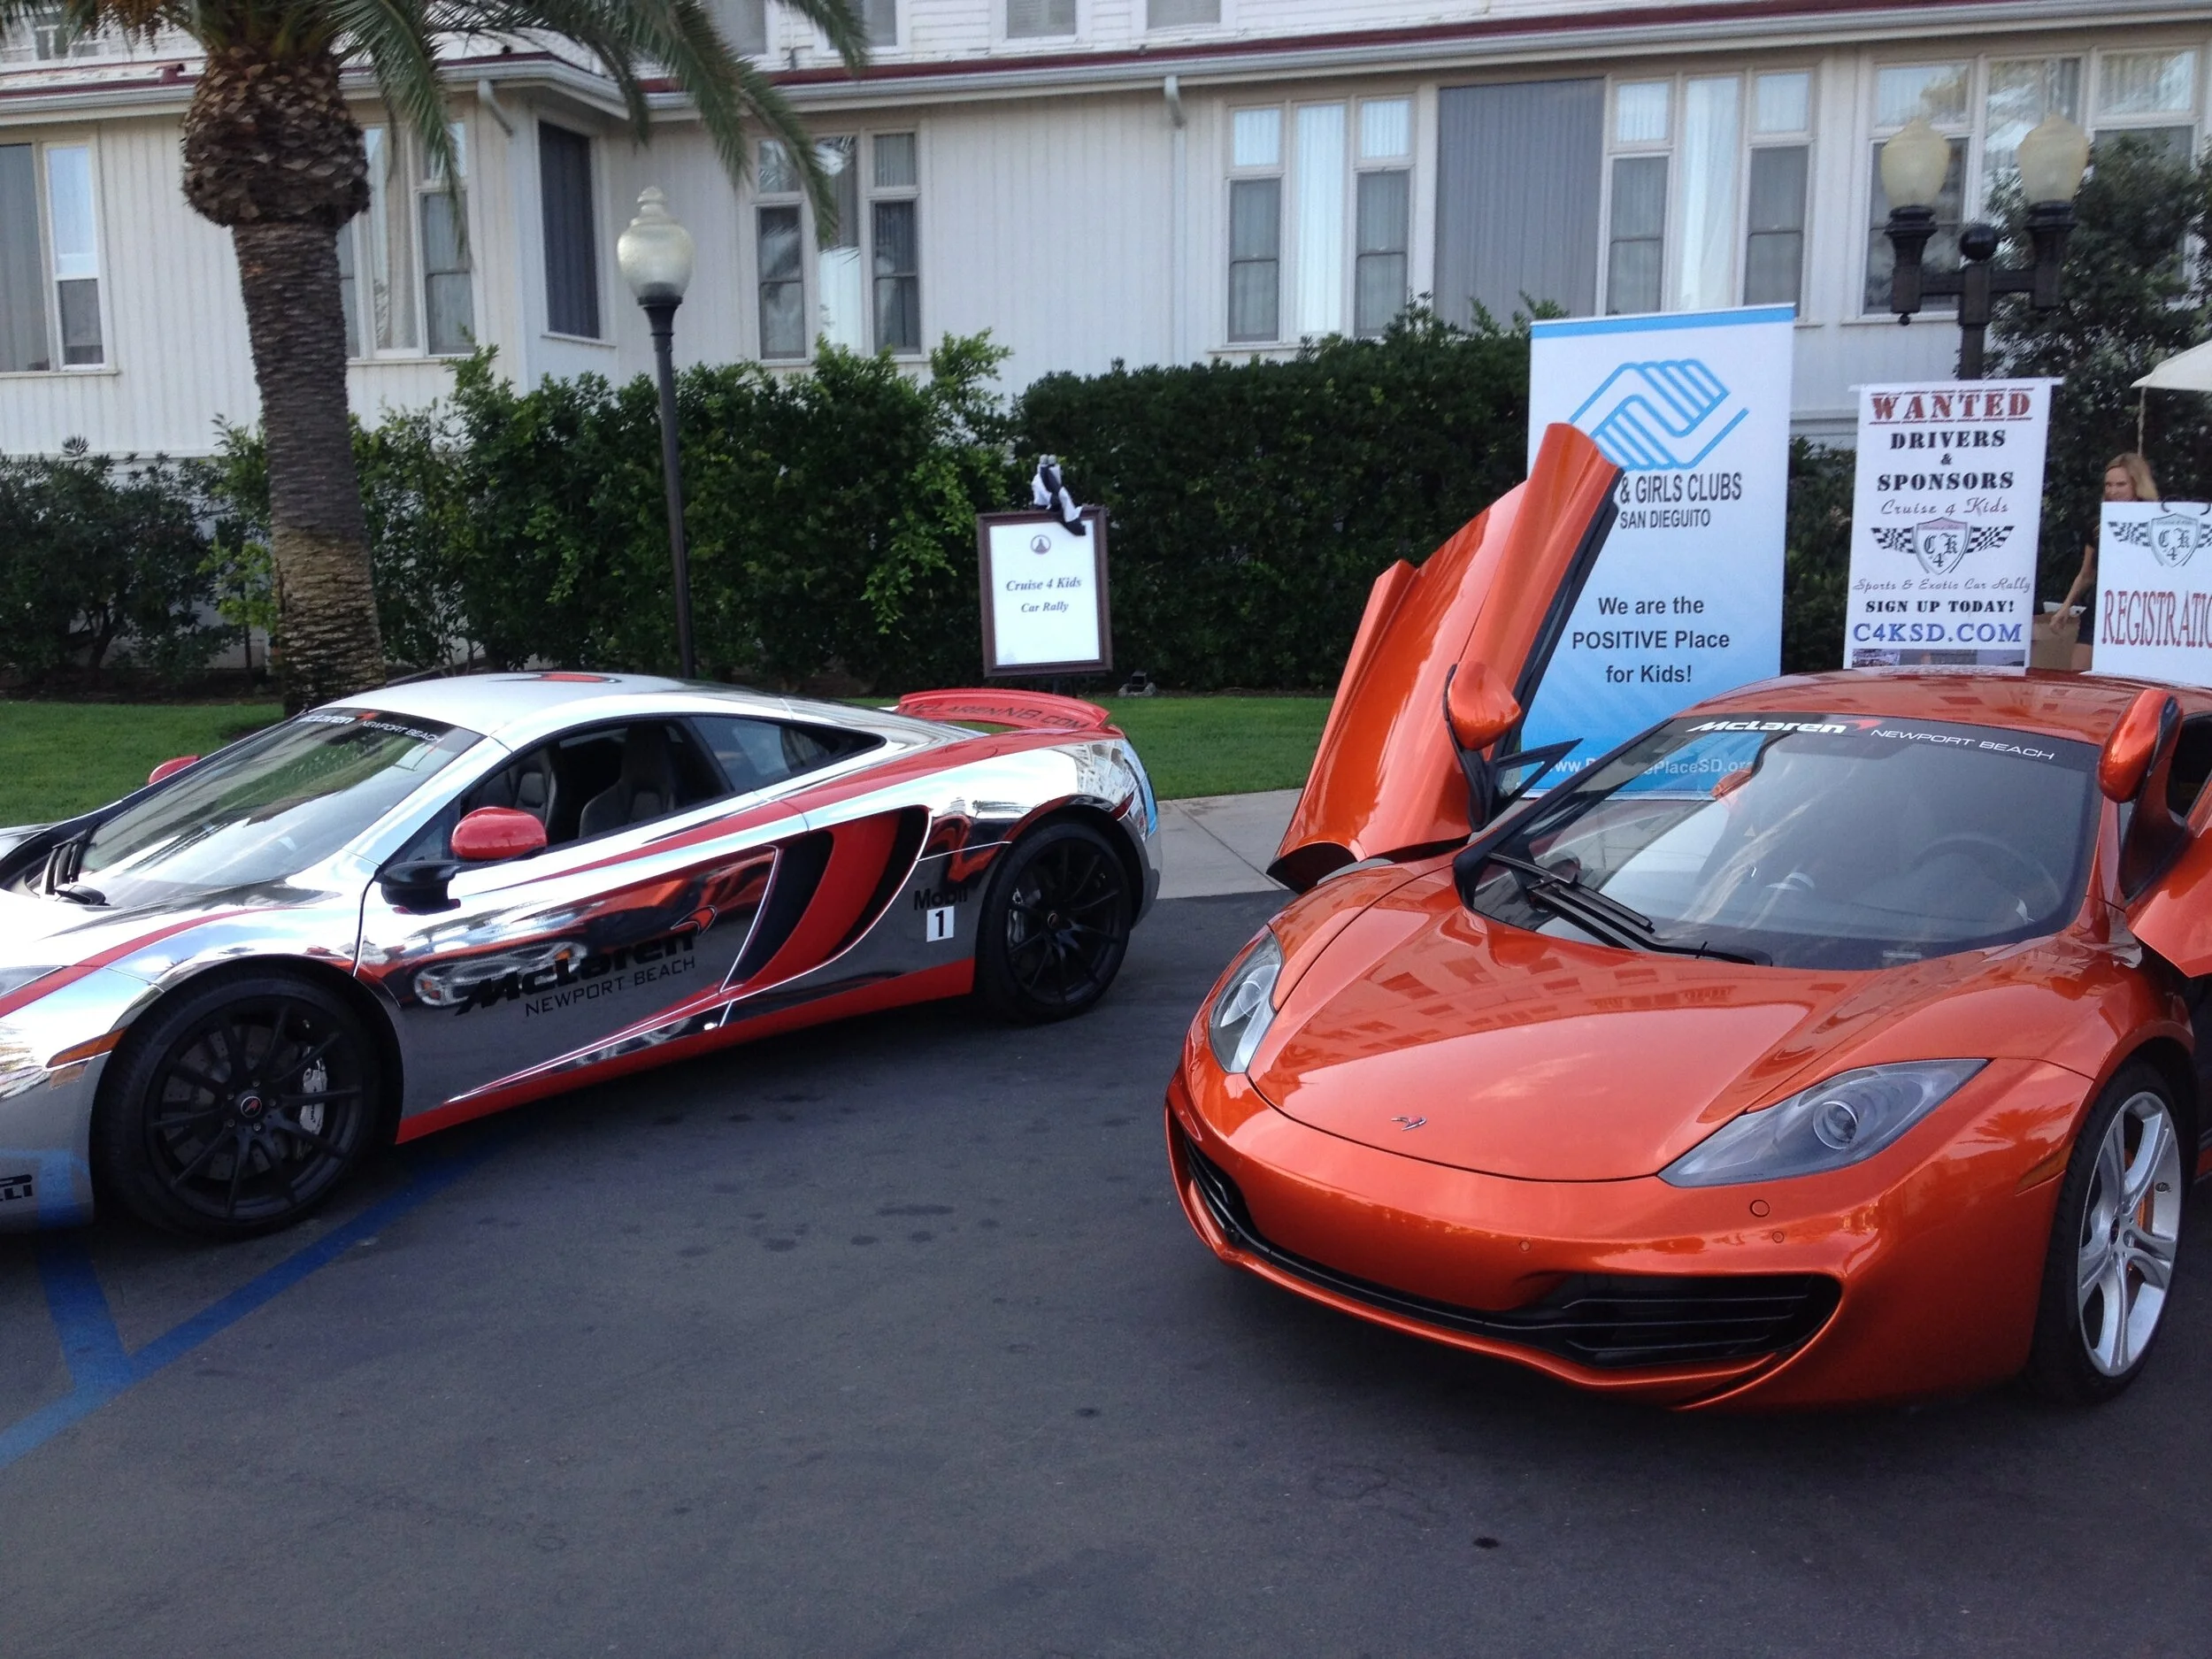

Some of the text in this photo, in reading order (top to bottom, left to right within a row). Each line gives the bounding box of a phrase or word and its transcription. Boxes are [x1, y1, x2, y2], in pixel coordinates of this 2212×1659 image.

[1871, 391, 2031, 421] WANTED
[1890, 429, 2007, 449] DRIVERS
[1940, 452, 1953, 466] &
[1619, 472, 1742, 504] & GIRLS CLUBS
[1877, 471, 2015, 492] SPONSORS
[1880, 498, 1938, 515] Cruise
[1963, 496, 2009, 514] Kids
[1619, 508, 1711, 530] SAN DIEGUITO
[1006, 576, 1083, 592] Cruise 4 Kids
[1853, 576, 2032, 594] Sports & Exotic Car Rally
[1021, 600, 1070, 614] Car Rally
[1598, 595, 1705, 616] We are the
[1865, 600, 2015, 613] SIGN UP TODAY!
[1571, 630, 1731, 650] POSITIVE Place
[1853, 622, 2024, 642] C4KSD.COM
[1605, 664, 1693, 684] for Kids!
[362, 720, 408, 735] NEWPORT
[404, 728, 445, 742] BEACH
[1686, 720, 2056, 761] McLaren NEWPORT BEACH
[913, 887, 968, 910] Mobil
[934, 910, 944, 938] 1
[455, 933, 696, 1017] McLaren
[524, 956, 696, 1018] NEWPORT BEACH
